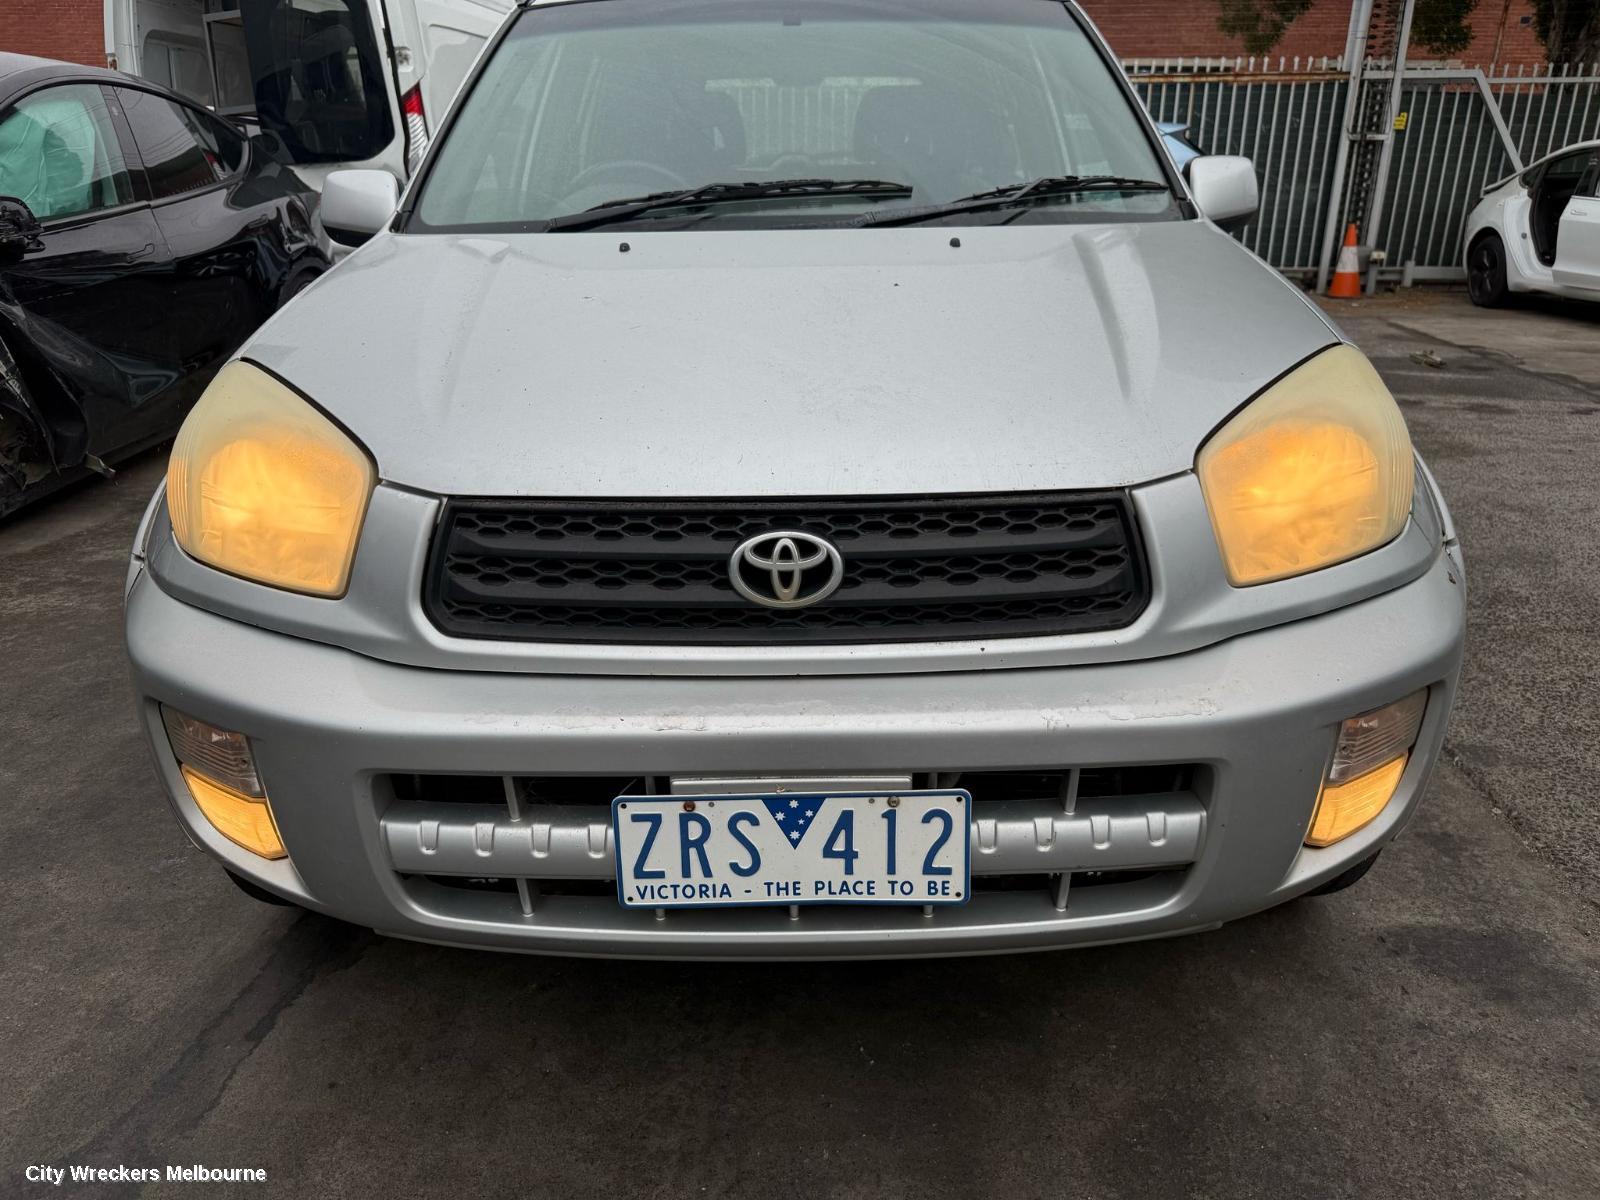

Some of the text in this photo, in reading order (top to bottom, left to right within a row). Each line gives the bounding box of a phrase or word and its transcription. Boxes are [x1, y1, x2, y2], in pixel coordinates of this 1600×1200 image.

[631, 808, 953, 879] ZRS 412
[635, 883, 732, 900] VICTORIA
[764, 881, 802, 896] THE
[814, 880, 877, 896] PLACE
[888, 880, 914, 896] TO
[927, 880, 950, 896] BE
